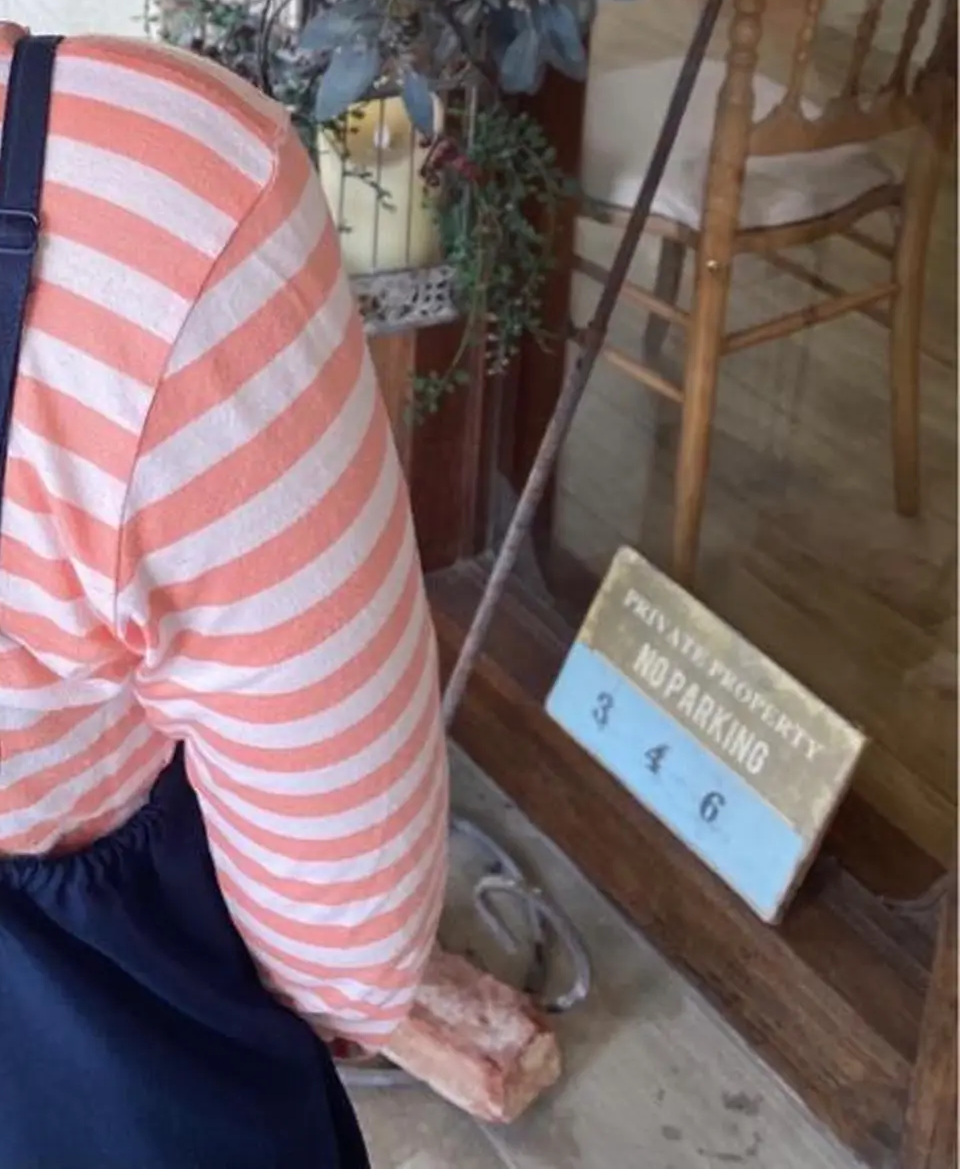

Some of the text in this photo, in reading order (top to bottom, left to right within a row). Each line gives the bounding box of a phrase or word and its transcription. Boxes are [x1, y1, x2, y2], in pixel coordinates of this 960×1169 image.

[623, 587, 825, 761] PRIVATE PROPERTY
[632, 642, 770, 775] NO PARKING
[592, 691, 727, 823] 3 4 6
